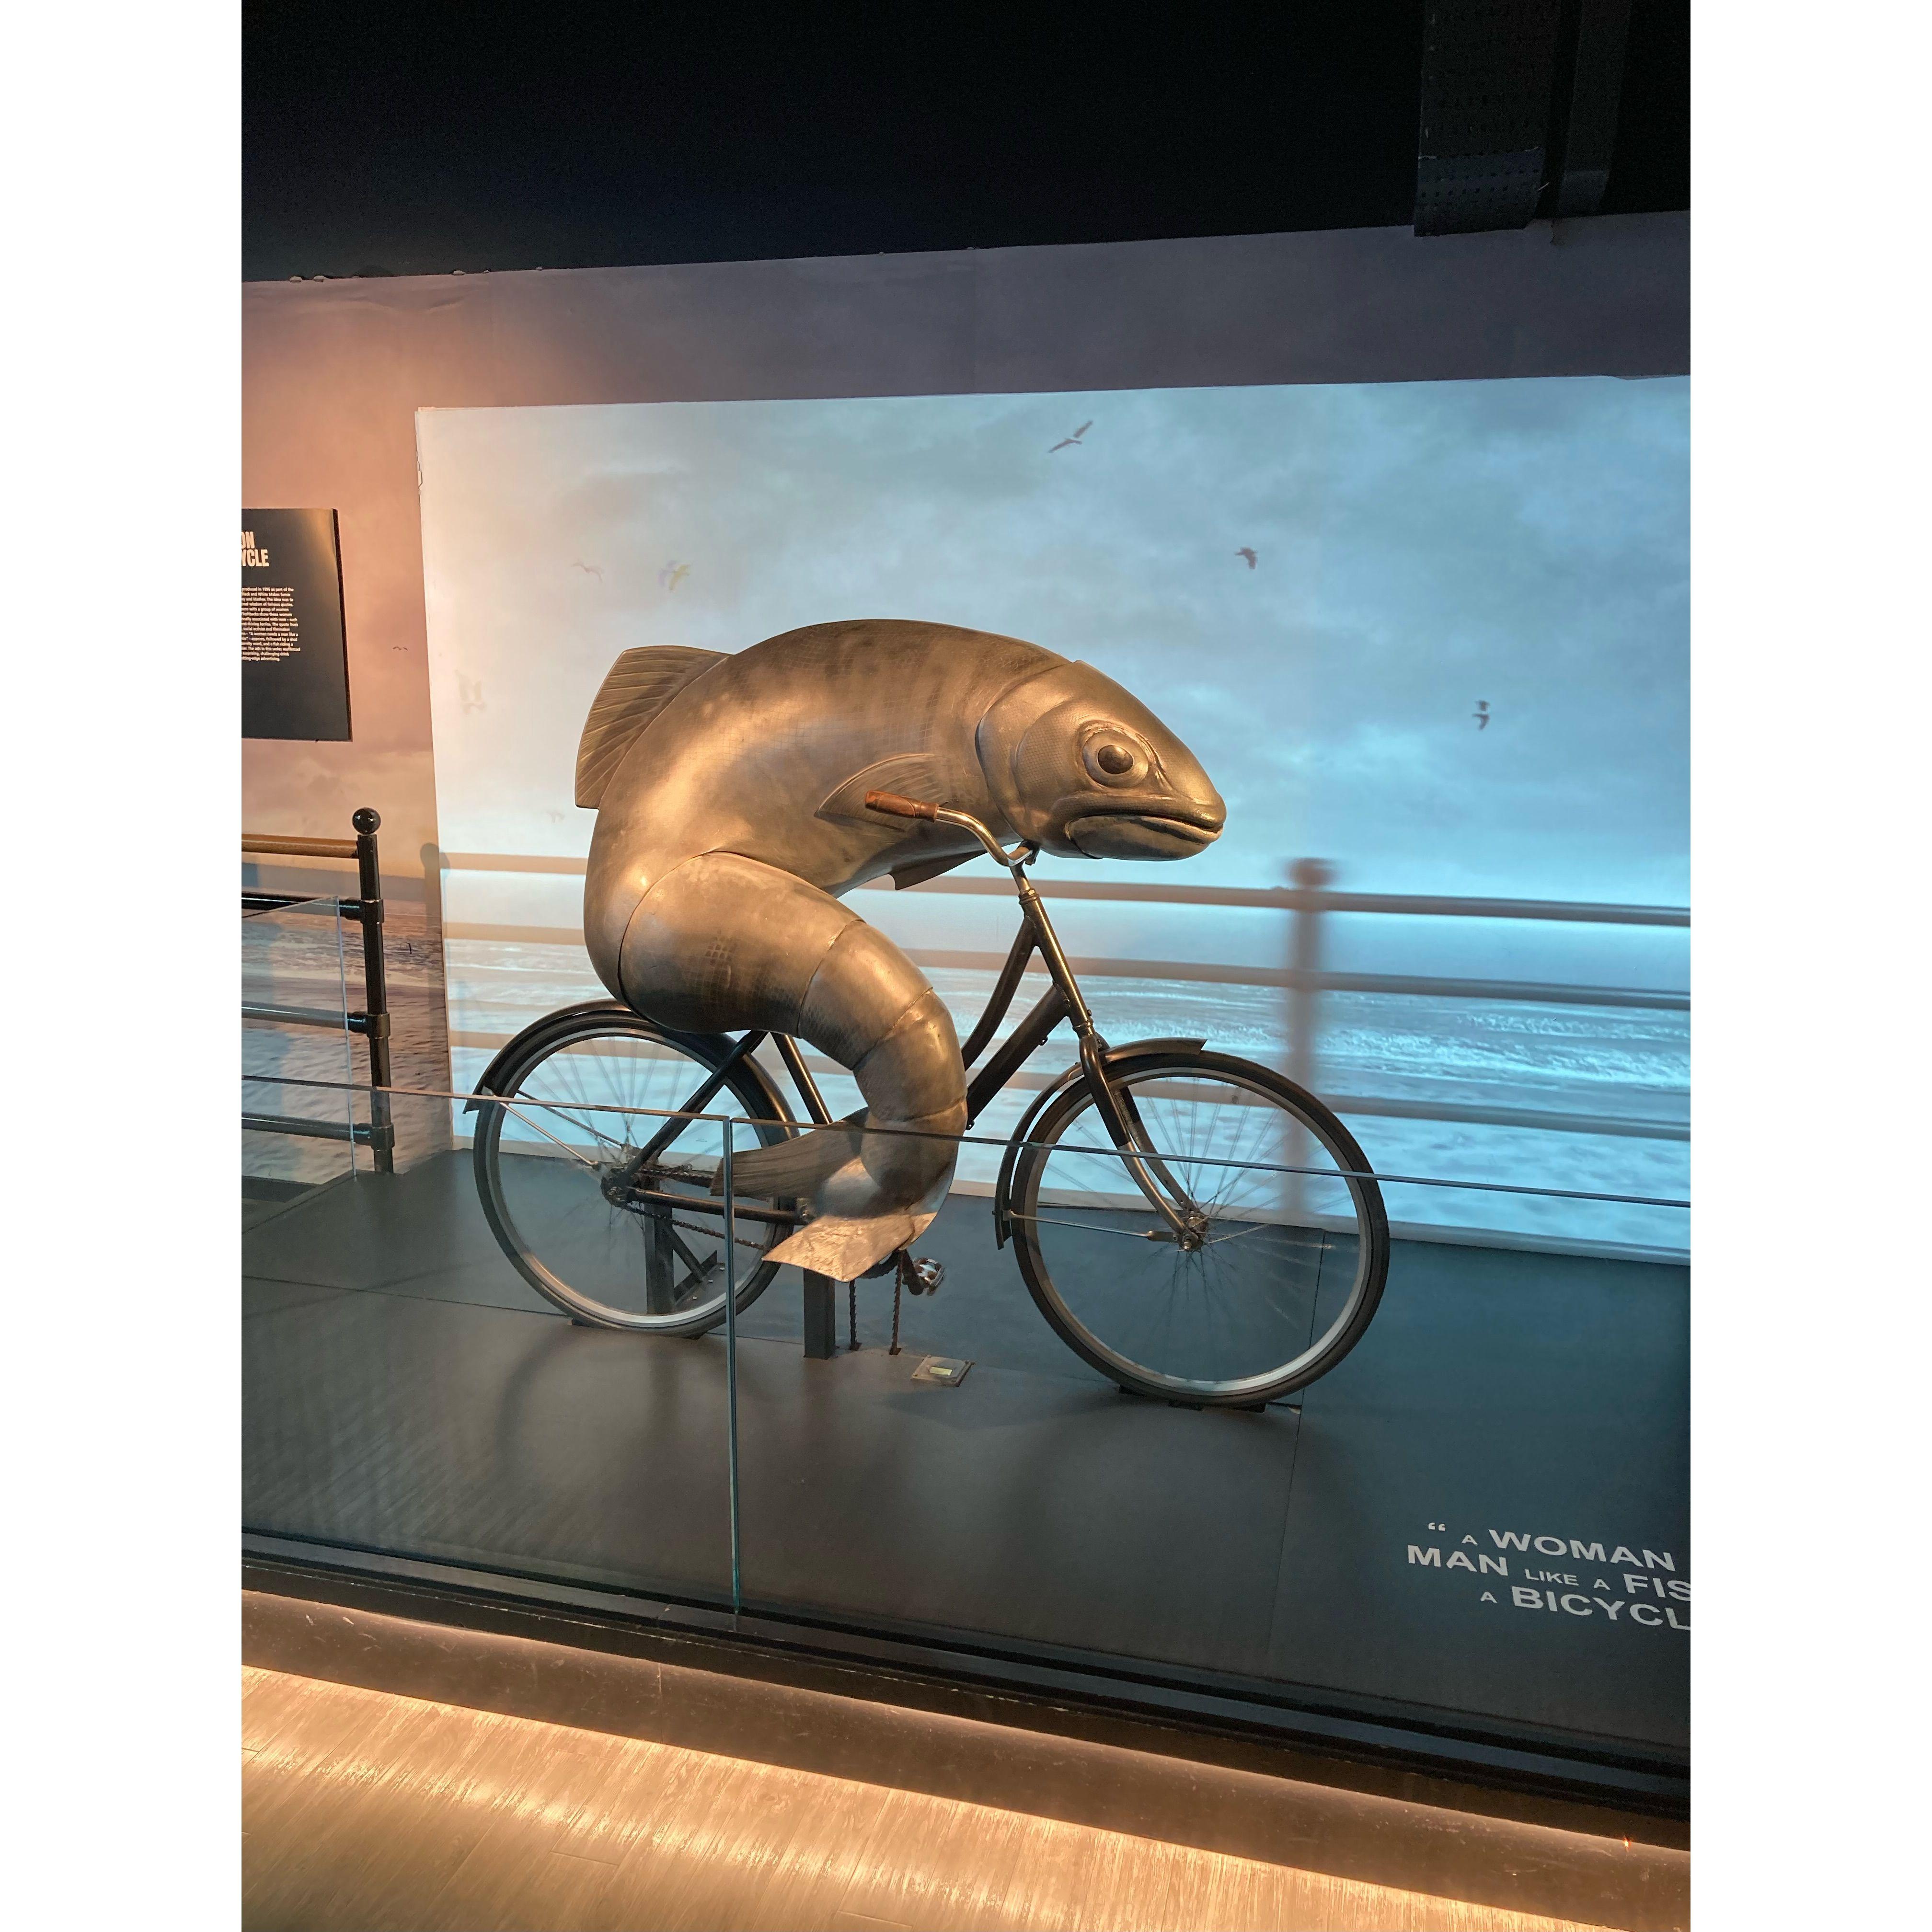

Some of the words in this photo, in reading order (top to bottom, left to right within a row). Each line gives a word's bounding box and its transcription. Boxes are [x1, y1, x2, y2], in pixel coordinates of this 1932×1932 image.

[1461, 1534, 1477, 1545] A
[1488, 1529, 1676, 1571] WOMAN
[1408, 1545, 1508, 1576] MAN
[1525, 1568, 1579, 1587] LIKE
[1593, 1579, 1611, 1590] A
[1623, 1574, 1690, 1602] FIS
[1480, 1592, 1498, 1603] A
[1511, 1586, 1690, 1631] BICYCL
